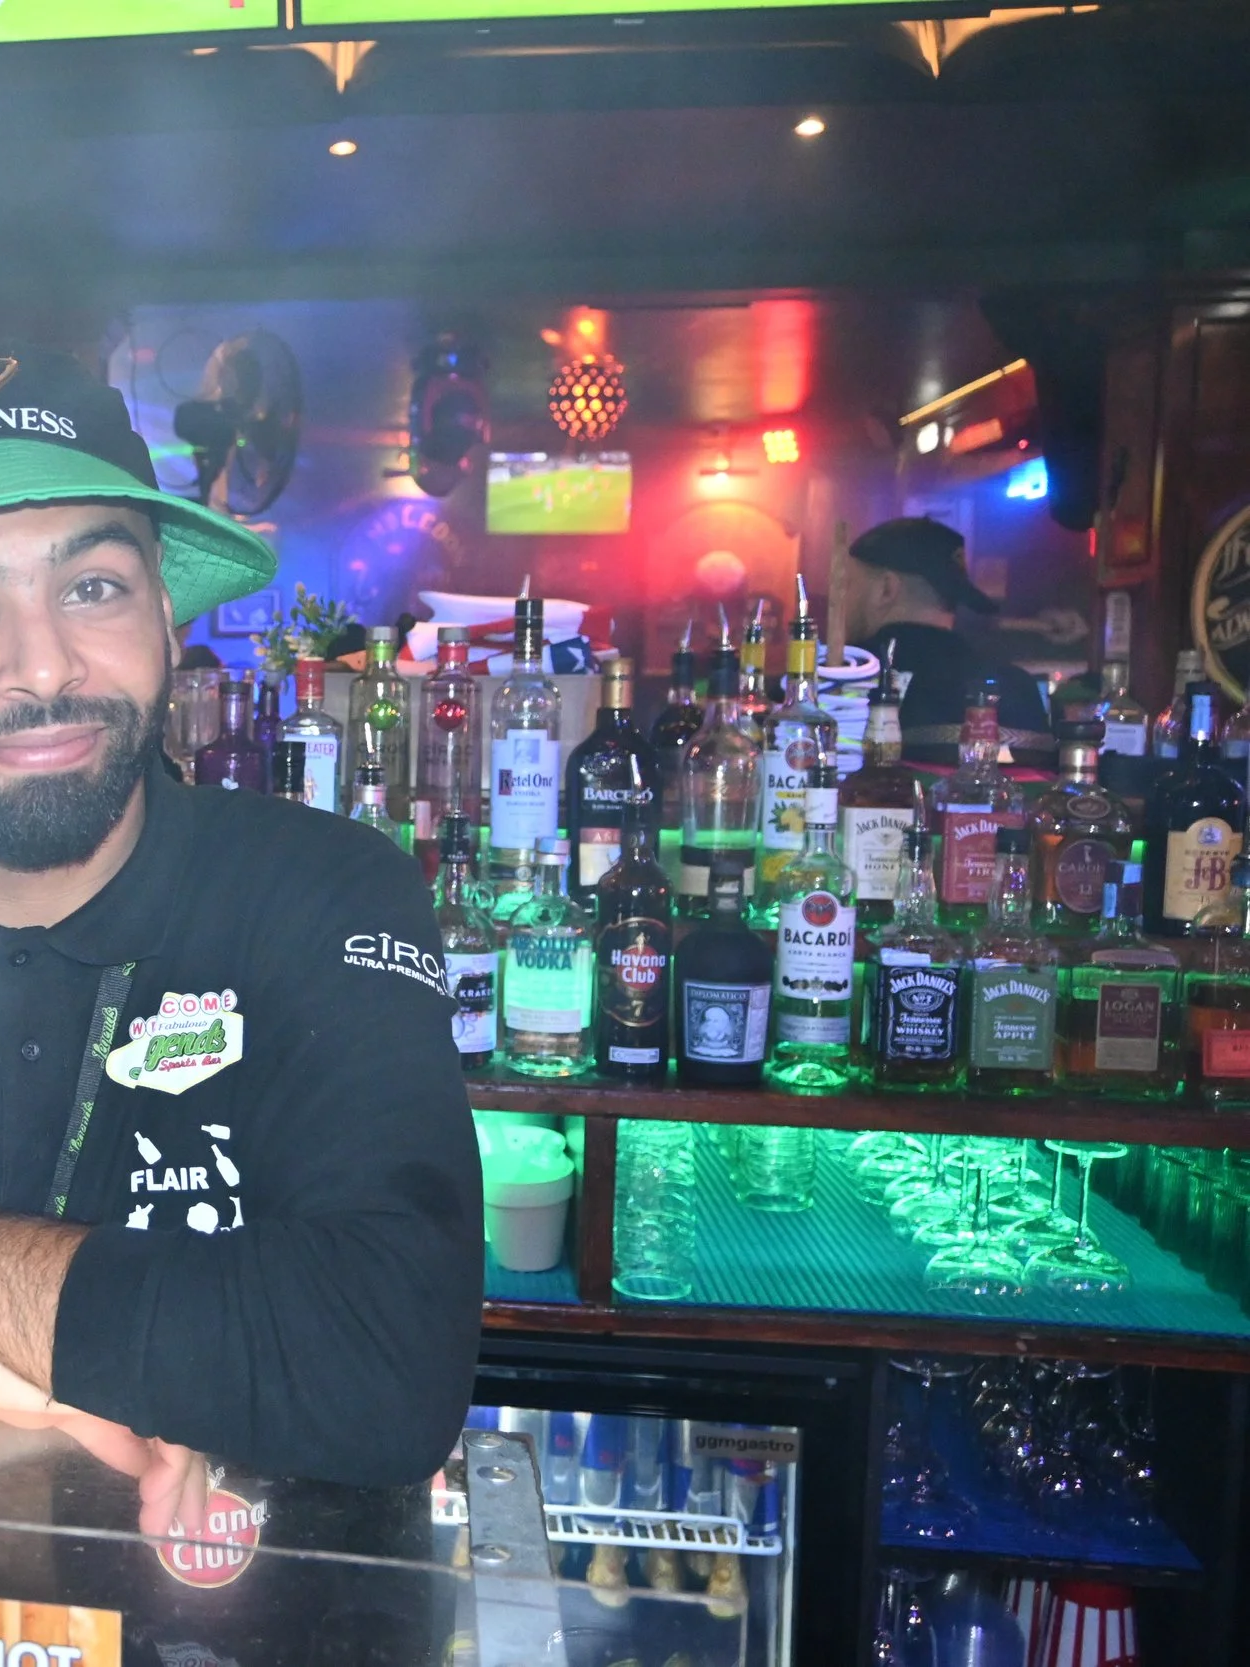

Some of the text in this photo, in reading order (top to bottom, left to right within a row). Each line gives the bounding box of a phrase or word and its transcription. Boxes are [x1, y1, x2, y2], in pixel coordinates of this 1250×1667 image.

[516, 951, 573, 970] VODKA
[611, 949, 666, 969] Havana
[344, 954, 437, 989] ULTRA PREMIUM
[622, 966, 657, 984] Club
[890, 971, 958, 996] JACK DANIEL'S
[982, 979, 1052, 1004] JACK DANIEL'S
[895, 1027, 945, 1037] WHISKEY
[993, 1032, 1036, 1041] APPLE
[158, 1055, 222, 1073] Sports Bar
[130, 1166, 210, 1193] FLAIR
[694, 1432, 795, 1455] ggmgastro
[172, 1535, 244, 1572] Club
